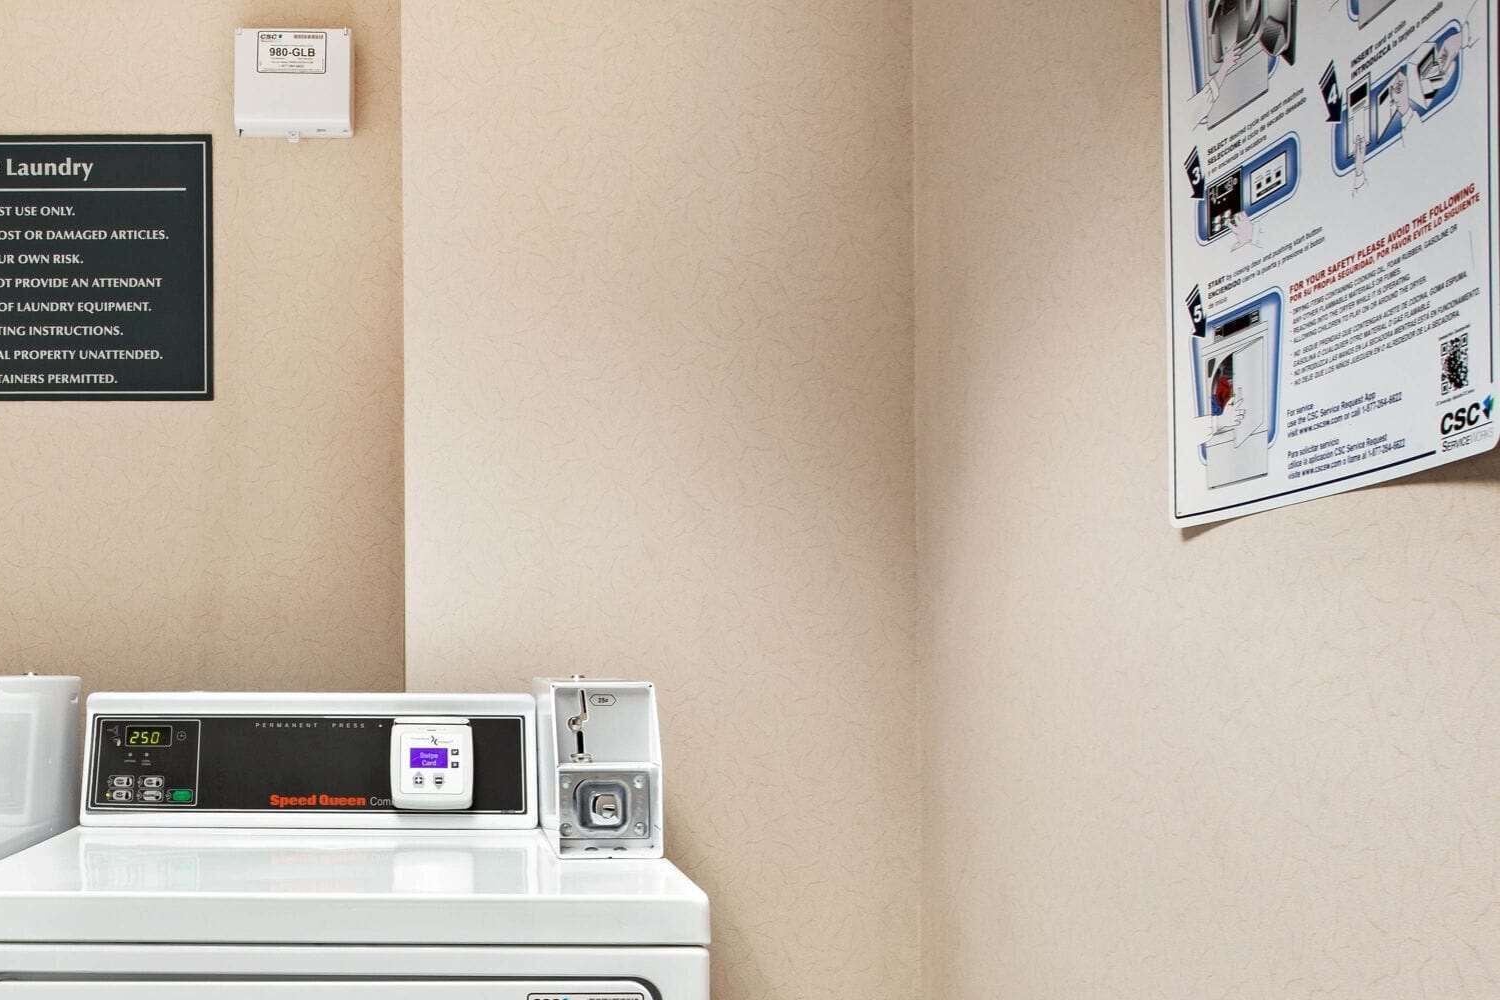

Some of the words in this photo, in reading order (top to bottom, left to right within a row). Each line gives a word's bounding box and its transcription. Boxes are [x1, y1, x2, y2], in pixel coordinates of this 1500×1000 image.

[269, 48, 316, 57] 980-GLB
[1328, 83, 1338, 104] 4
[1208, 138, 1228, 155] SELECT
[6, 157, 93, 180] Laundry
[1192, 166, 1200, 184] 3
[14, 206, 37, 216] USE
[40, 206, 75, 216] ONLY.
[24, 230, 43, 240] OR
[46, 230, 107, 240] DAMAGED
[110, 229, 168, 240] ARTICLES.
[1290, 278, 1304, 294] FOR
[1305, 269, 1325, 286] YOUR
[1327, 256, 1355, 276] SAFETY
[1357, 238, 1385, 258] PLEASE
[1388, 224, 1410, 244] AVOID
[1412, 213, 1427, 229] THE
[1429, 183, 1475, 220] FOLLOWING
[1290, 290, 1302, 303] POR
[1304, 286, 1312, 297] SU
[1313, 275, 1336, 292] PROPIA
[1376, 248, 1390, 260] POR
[1391, 235, 1412, 253] FAVOR
[1413, 224, 1432, 240] EVITE
[1434, 219, 1442, 230] LO
[1444, 193, 1480, 221] SIGUIENTE
[18, 254, 49, 264] OWN
[53, 254, 83, 264] RISK.
[15, 278, 68, 288] PROVIDE
[71, 278, 88, 287] AN
[92, 277, 161, 287] ATTENDANT
[1208, 276, 1225, 289] START
[17, 302, 74, 312] LAUNDRY
[77, 301, 151, 313] EQUIPMENT.
[1194, 305, 1202, 322] 5
[29, 325, 123, 336] INSTRUCTIONS.
[14, 350, 75, 360] PROPERTY
[79, 349, 162, 359] UNATTENDED.
[48, 373, 117, 383] PERMITTED.
[1441, 402, 1480, 435] CSC
[270, 794, 316, 807] Speed
[319, 795, 366, 806] Queen
